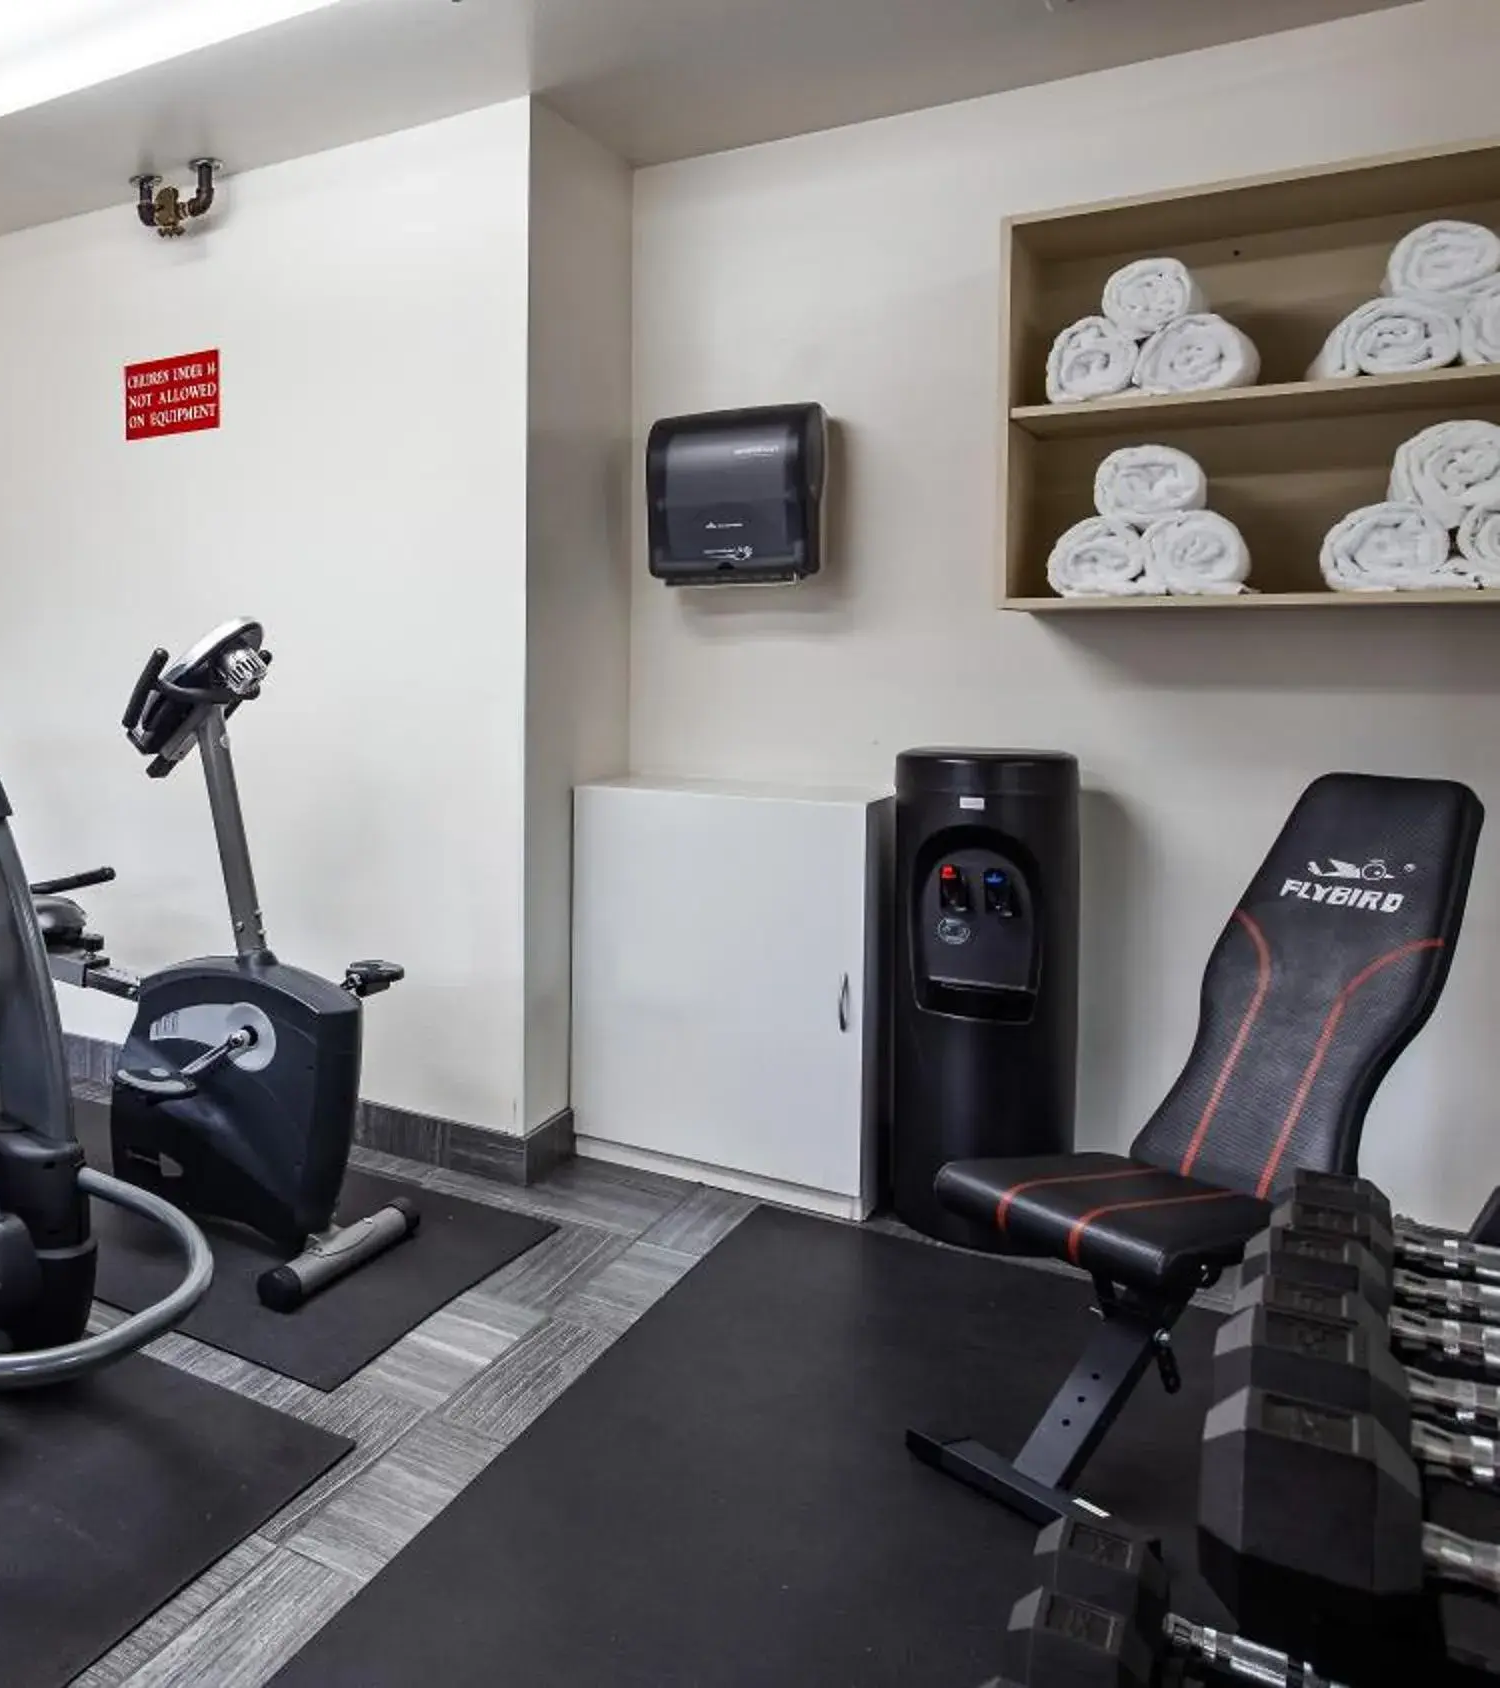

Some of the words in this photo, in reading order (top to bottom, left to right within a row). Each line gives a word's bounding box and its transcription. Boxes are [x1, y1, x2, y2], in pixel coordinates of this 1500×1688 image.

[128, 369, 170, 389] CHILDREN
[173, 363, 203, 381] UNDER
[128, 393, 153, 409] NOT
[158, 381, 217, 405] ALLOWED
[128, 414, 145, 429] ON
[150, 403, 217, 428] EQUIPMENT
[1279, 877, 1405, 914] FLYBIRD
